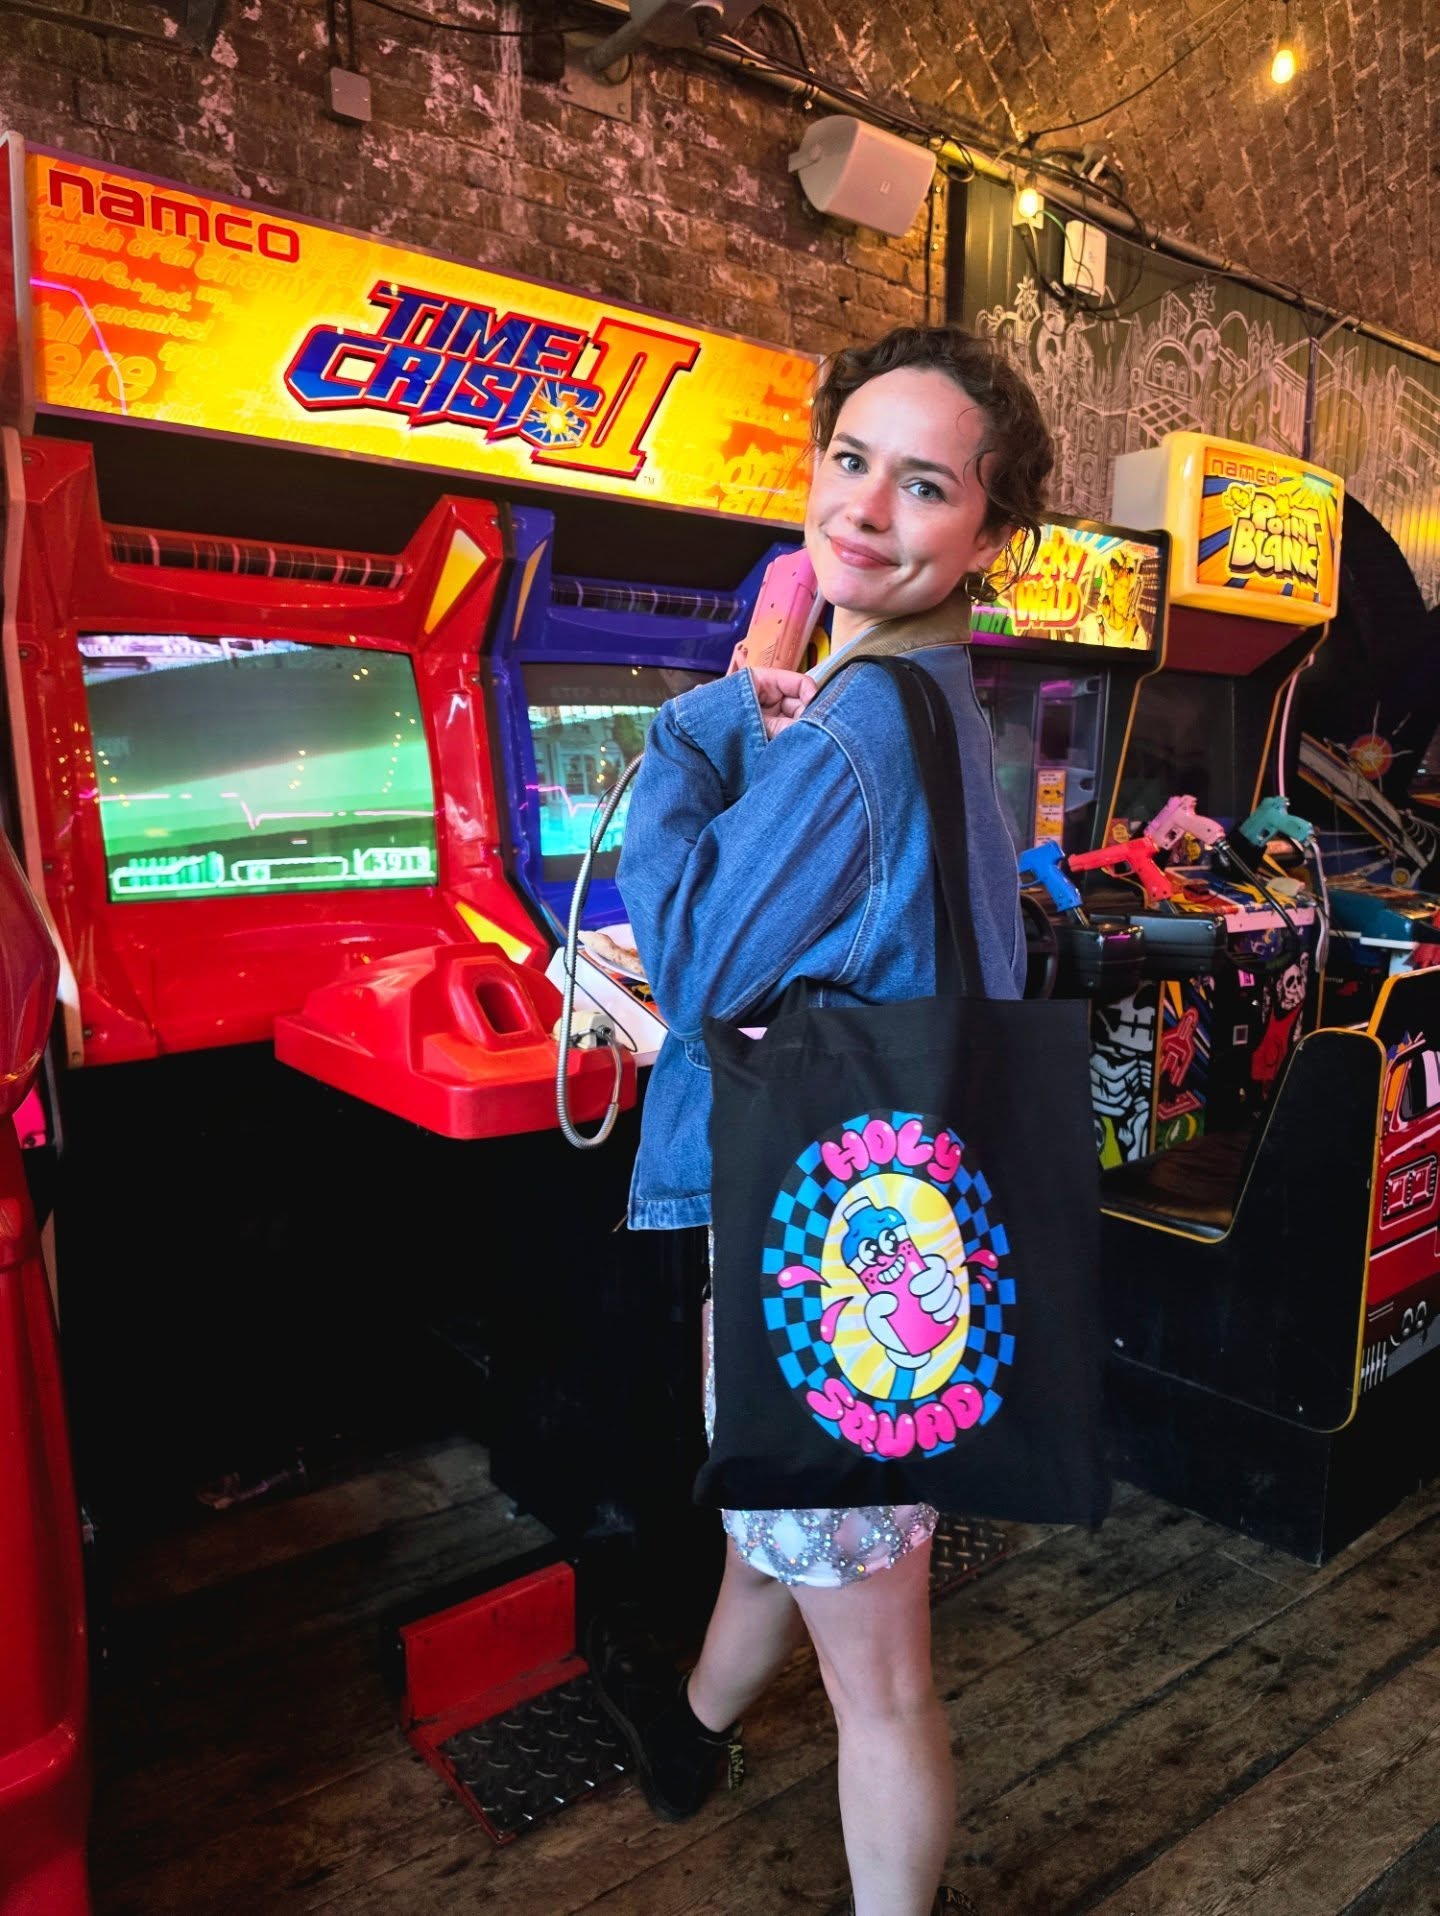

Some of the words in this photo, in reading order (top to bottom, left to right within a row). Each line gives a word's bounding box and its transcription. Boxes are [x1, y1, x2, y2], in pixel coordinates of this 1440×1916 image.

[48, 169, 300, 263] namco
[367, 279, 590, 379] TIME
[284, 323, 604, 449] CRISIS
[531, 317, 700, 480] II
[1212, 459, 1280, 487] namco
[1229, 516, 1319, 584] BLANK
[1250, 492, 1321, 546] POINT
[1014, 578, 1081, 627] WILD
[820, 1119, 962, 1183] HOLY
[805, 1377, 984, 1458] SQUAD
